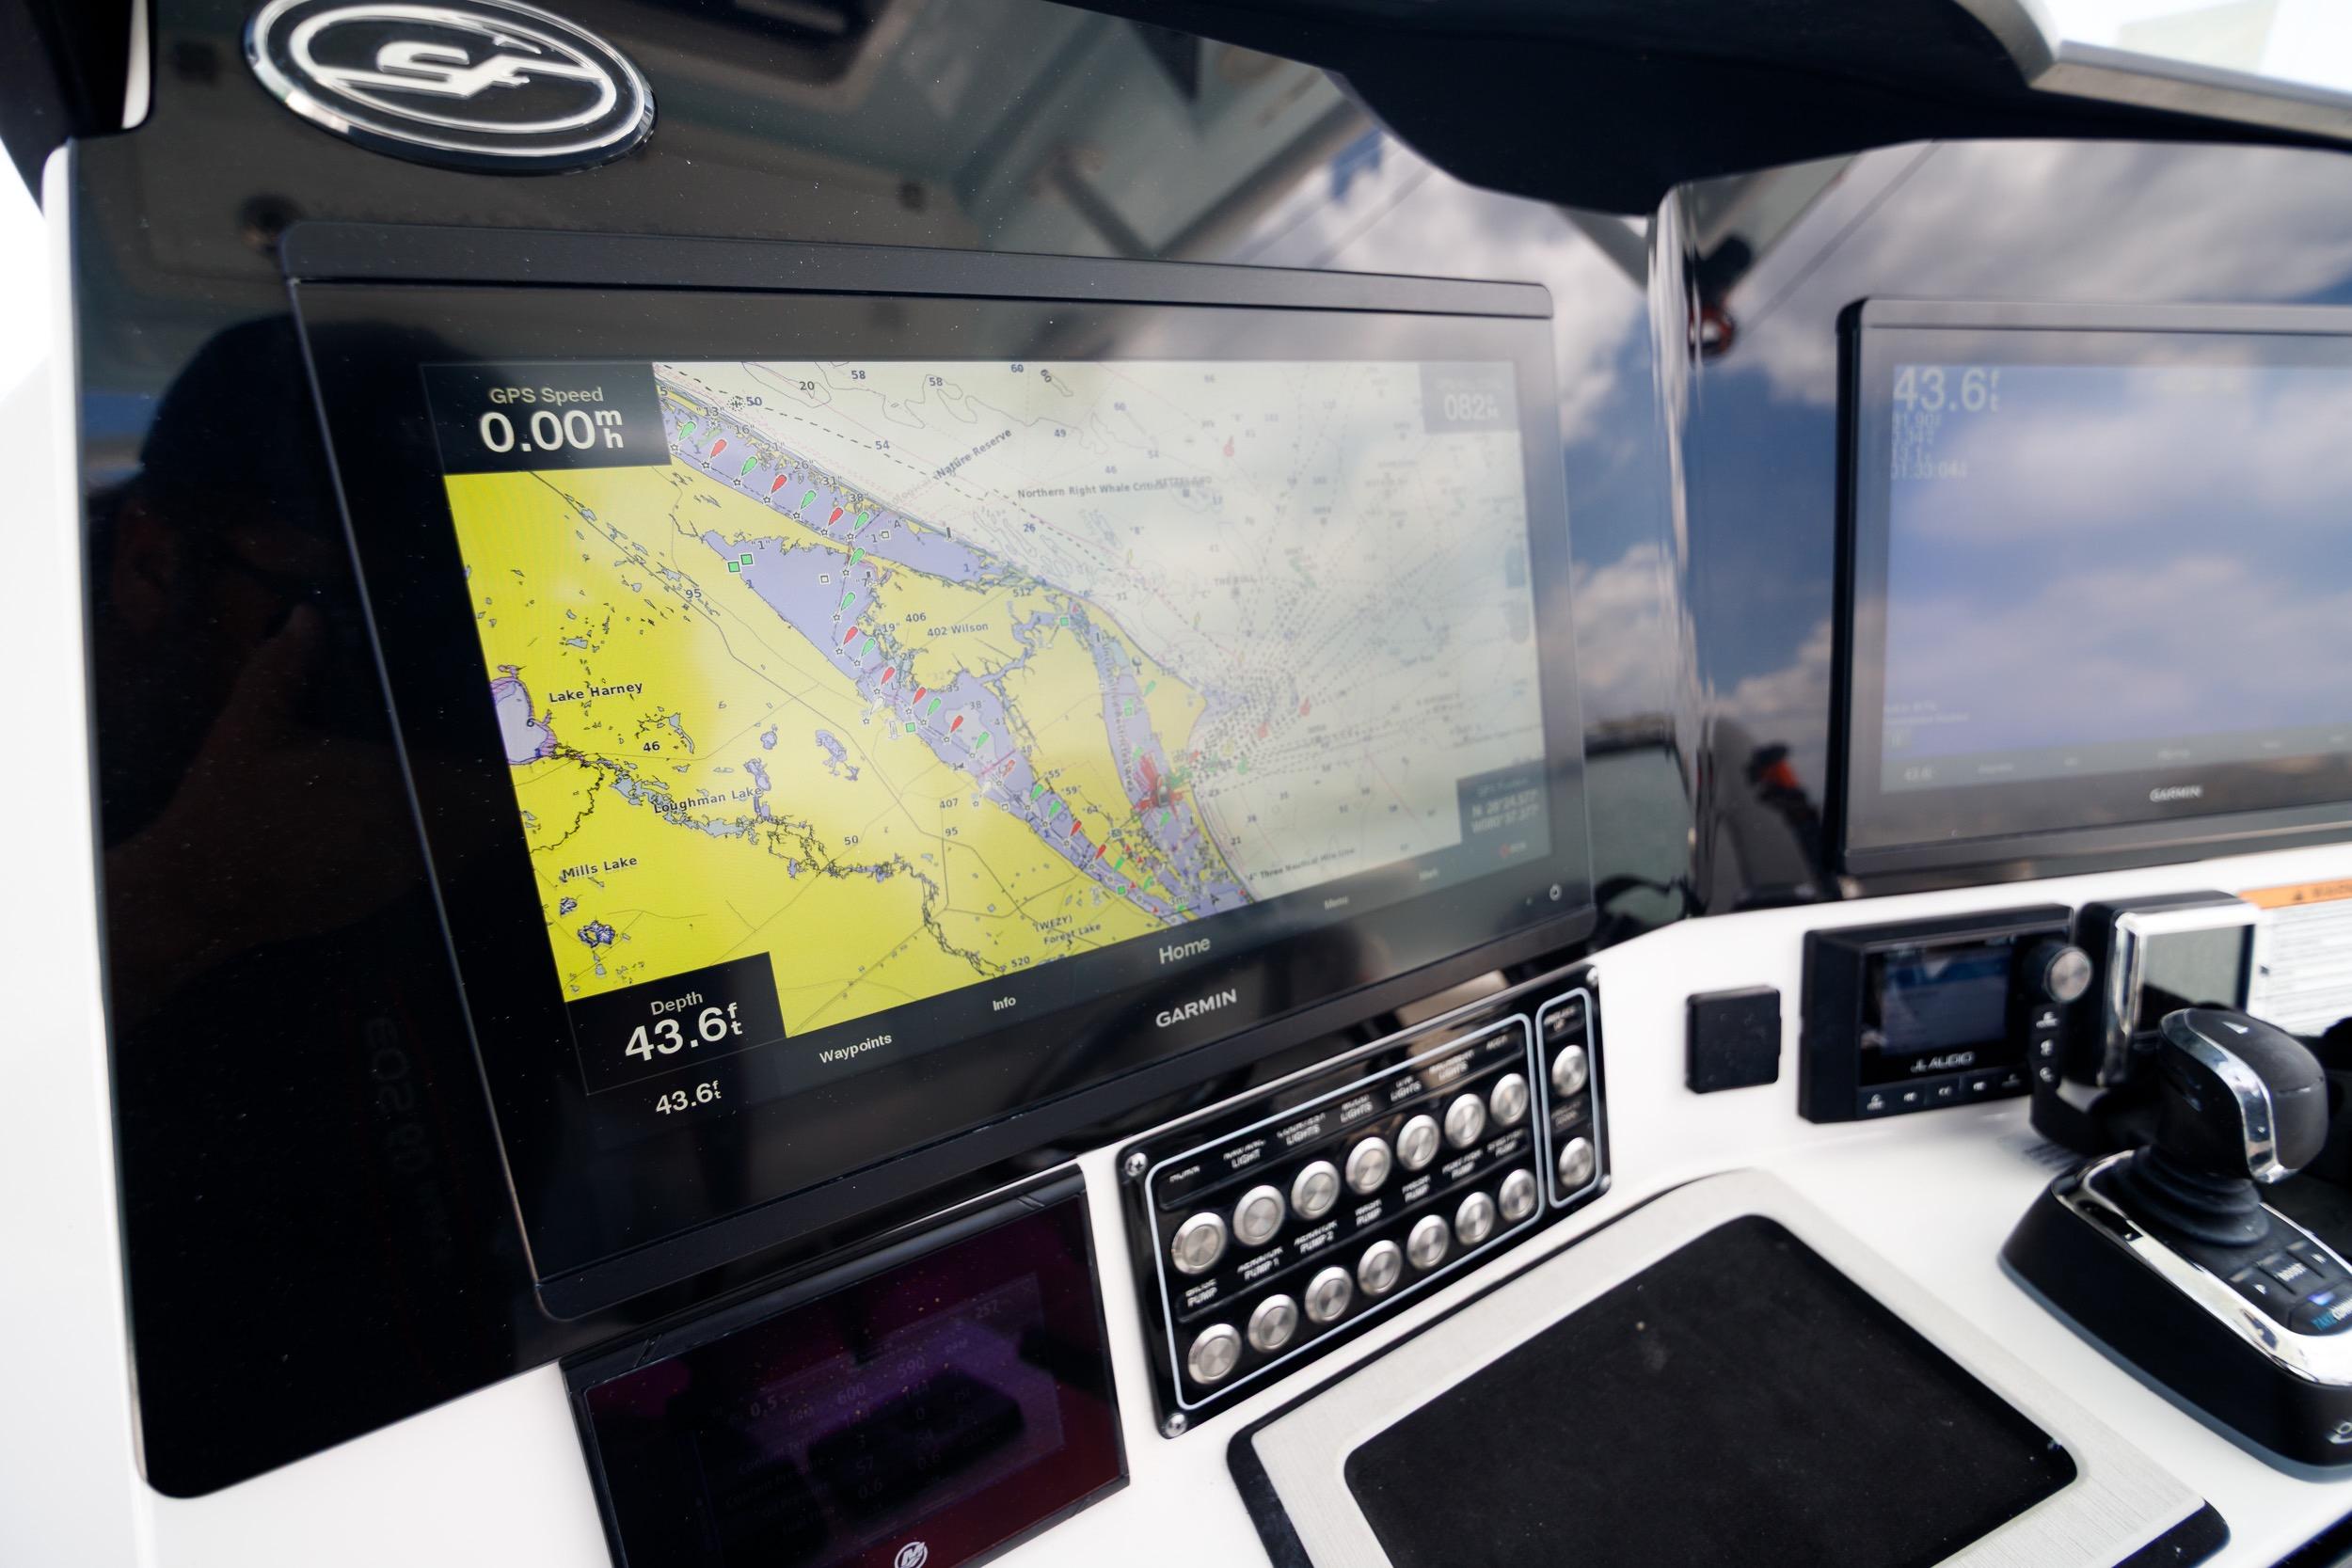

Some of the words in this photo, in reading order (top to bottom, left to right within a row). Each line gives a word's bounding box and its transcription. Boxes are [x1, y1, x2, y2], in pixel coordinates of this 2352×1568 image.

[851, 370, 866, 380] 58
[929, 376, 944, 387] 58
[800, 381, 815, 390] 20
[1893, 365, 1987, 412] 43.6
[489, 388, 536, 404] GPS
[541, 387, 604, 406] Speed
[746, 396, 763, 406] 50
[480, 409, 596, 453] 0.00
[875, 440, 890, 450] 54
[972, 429, 1012, 457] Reserve
[1017, 486, 1065, 499] Northern
[1069, 485, 1097, 497] Right
[1100, 483, 1130, 494] Whale
[1023, 523, 1036, 532] 26
[685, 588, 702, 599] 95
[1012, 587, 1033, 597] 512
[905, 612, 927, 624] 406
[927, 626, 948, 638] 402
[950, 622, 990, 635] Wilson
[548, 688, 584, 704] Lake
[590, 682, 644, 698] Harney
[526, 718, 535, 728] 6
[643, 740, 660, 753] 46
[653, 791, 726, 815] Loughman
[731, 785, 763, 800] Lake
[939, 798, 959, 809] 407
[2150, 785, 2203, 803] GARMIN
[844, 835, 859, 847] 50
[945, 827, 959, 837] 95
[563, 863, 599, 879] Mills
[603, 856, 638, 872] Lake
[1034, 914, 1073, 932] (WEZY)
[1043, 929, 1076, 945] Forest
[1078, 923, 1102, 937] Lake
[1159, 938, 1212, 964] Home
[1010, 956, 1031, 969] 520
[650, 990, 704, 1016] Depth
[993, 995, 1017, 1011] Info
[1155, 989, 1237, 1027] GARMIN
[625, 1006, 728, 1062] 43.6
[818, 1033, 893, 1064] Waypoints
[1928, 1051, 1976, 1070] AUDIO
[655, 1083, 713, 1116] 43.6
[1391, 1082, 1422, 1101] LIGHTS
[1340, 1102, 1374, 1123] LIGHTS
[1286, 1126, 1321, 1146] LIGHTS
[1232, 1149, 1262, 1168] LIGHT
[1452, 1162, 1476, 1180] PUMP
[1405, 1183, 1430, 1204] PUMP
[1356, 1207, 1383, 1227] PUMP
[1300, 1234, 1327, 1254] PUMP
[1244, 1260, 1273, 1280] PUMP
[1187, 1287, 1218, 1308] PUMP
